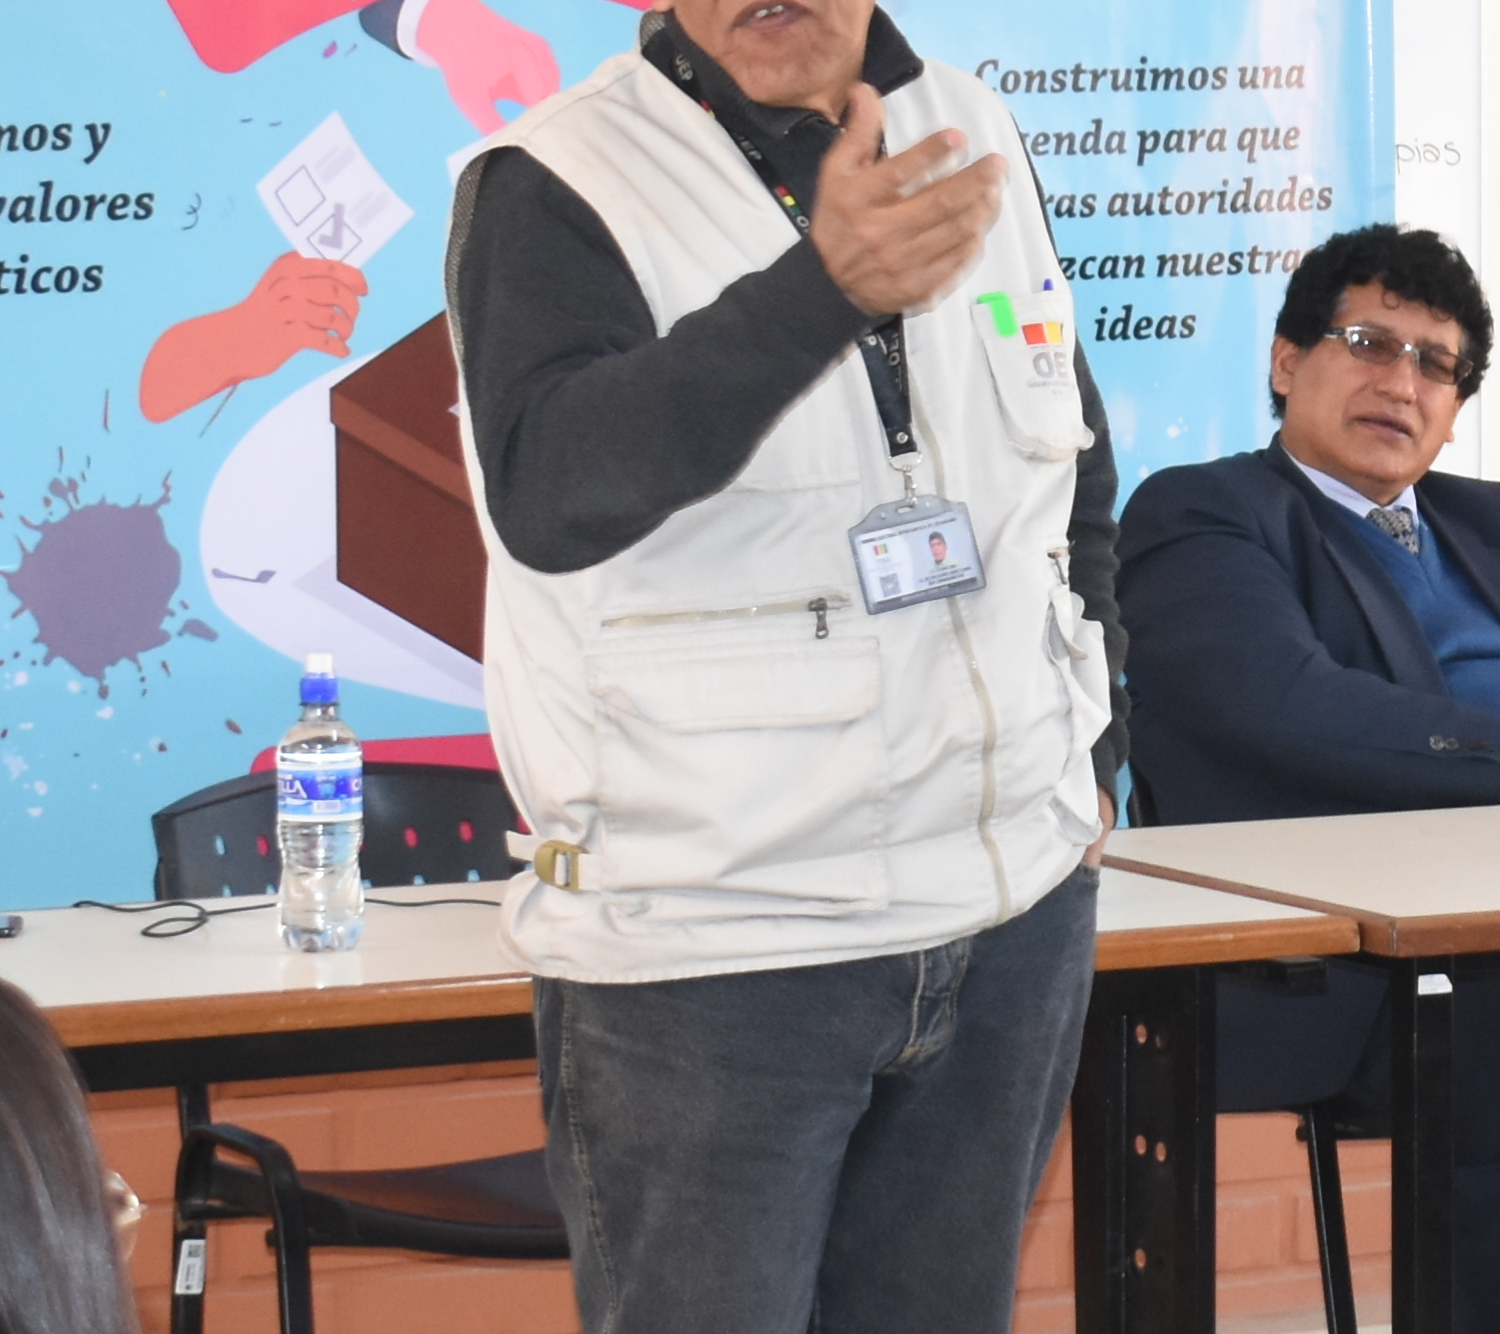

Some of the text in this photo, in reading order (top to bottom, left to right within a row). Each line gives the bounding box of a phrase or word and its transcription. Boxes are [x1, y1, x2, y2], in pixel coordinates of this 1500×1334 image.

[974, 56, 1306, 95] Construimos una
[83, 121, 112, 165] y
[1020, 118, 1302, 167] enda para que
[1106, 176, 1334, 218] autoridades
[1156, 244, 1310, 279] nuestra
[1094, 304, 1197, 342] ideas
